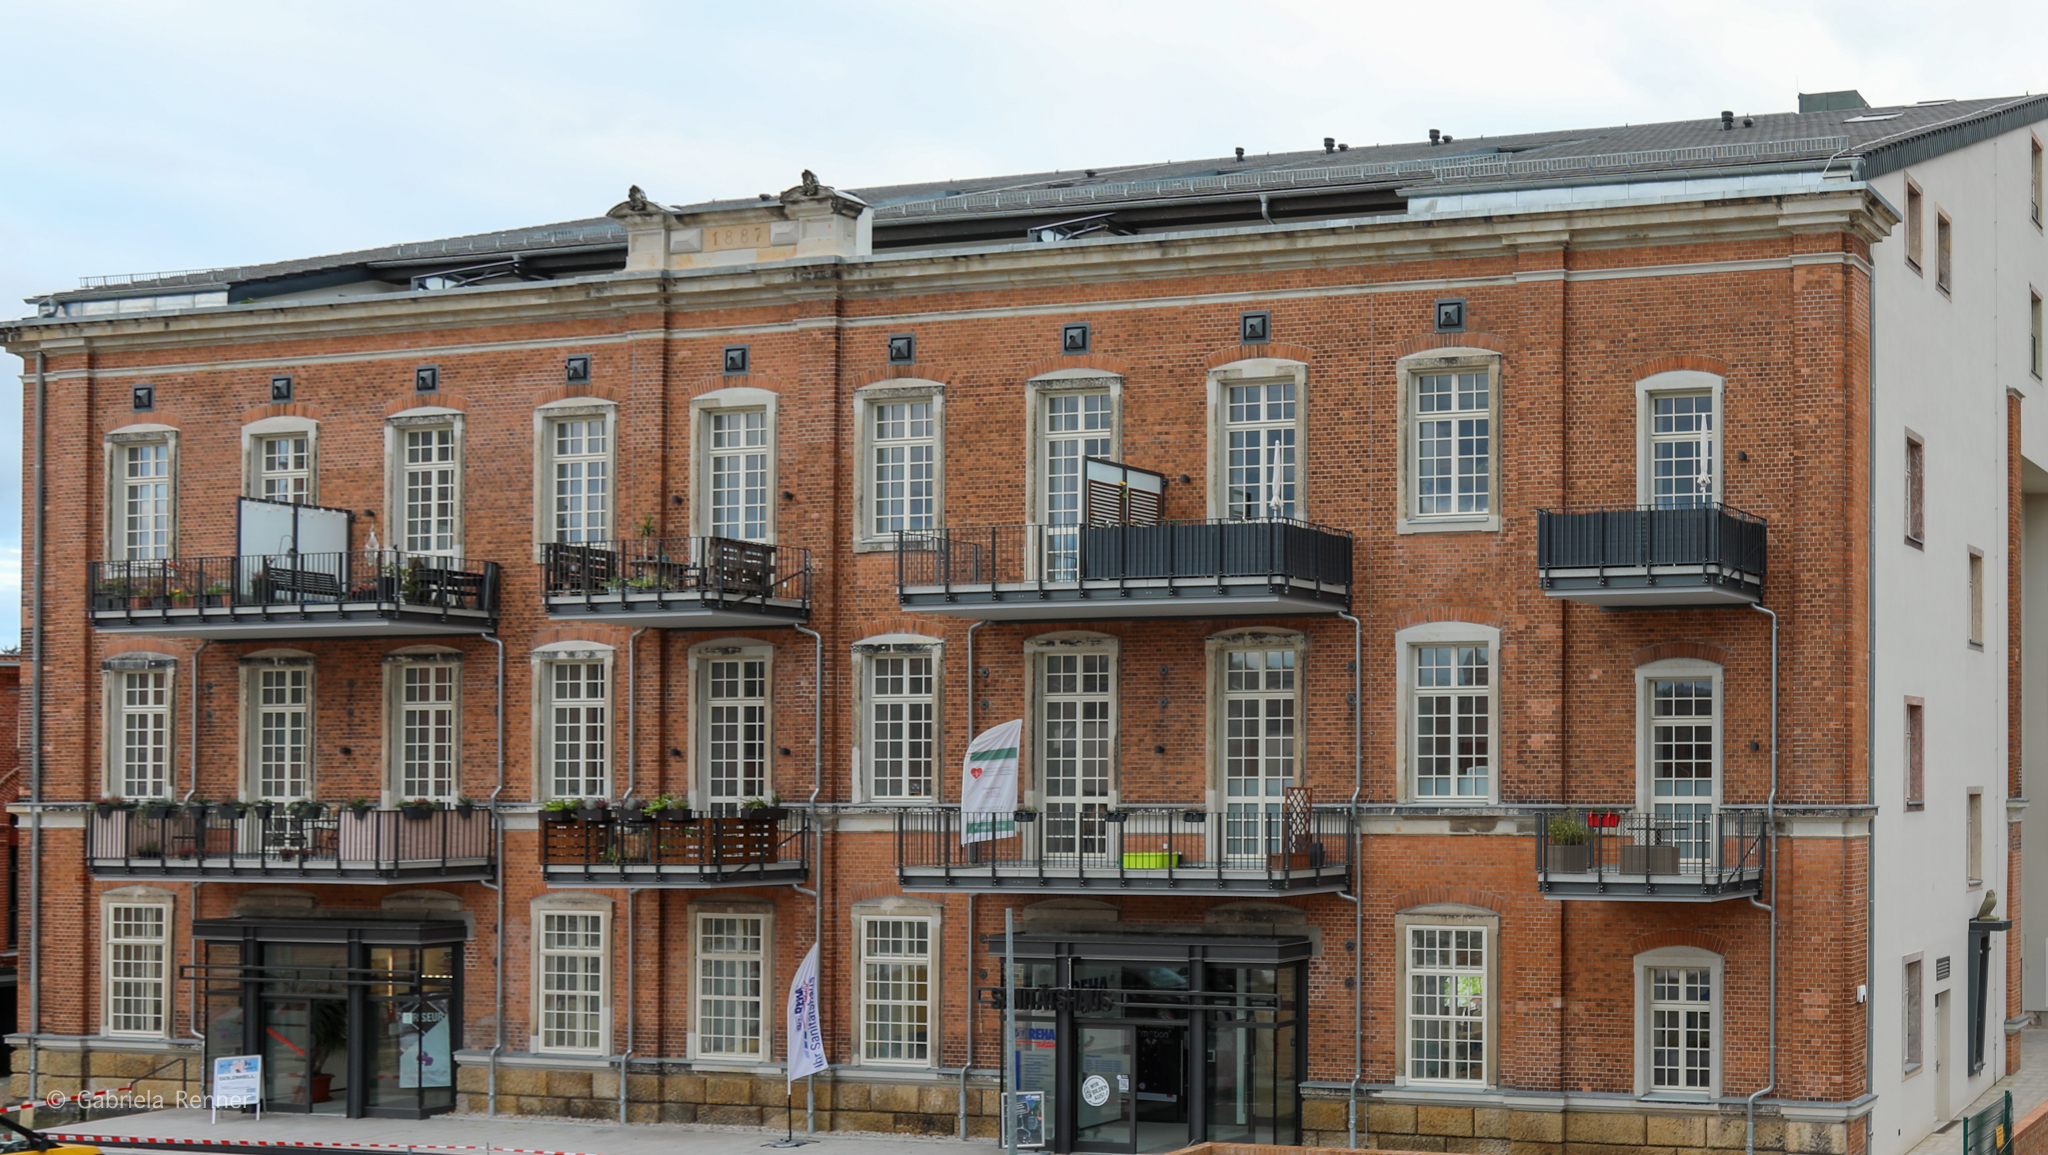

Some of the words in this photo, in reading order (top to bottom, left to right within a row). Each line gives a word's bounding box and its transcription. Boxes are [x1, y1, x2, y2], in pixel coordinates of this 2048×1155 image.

[711, 227, 761, 246] 1887
[1029, 1028, 1055, 1040] REHA
[813, 1052, 824, 1069] Ihr
